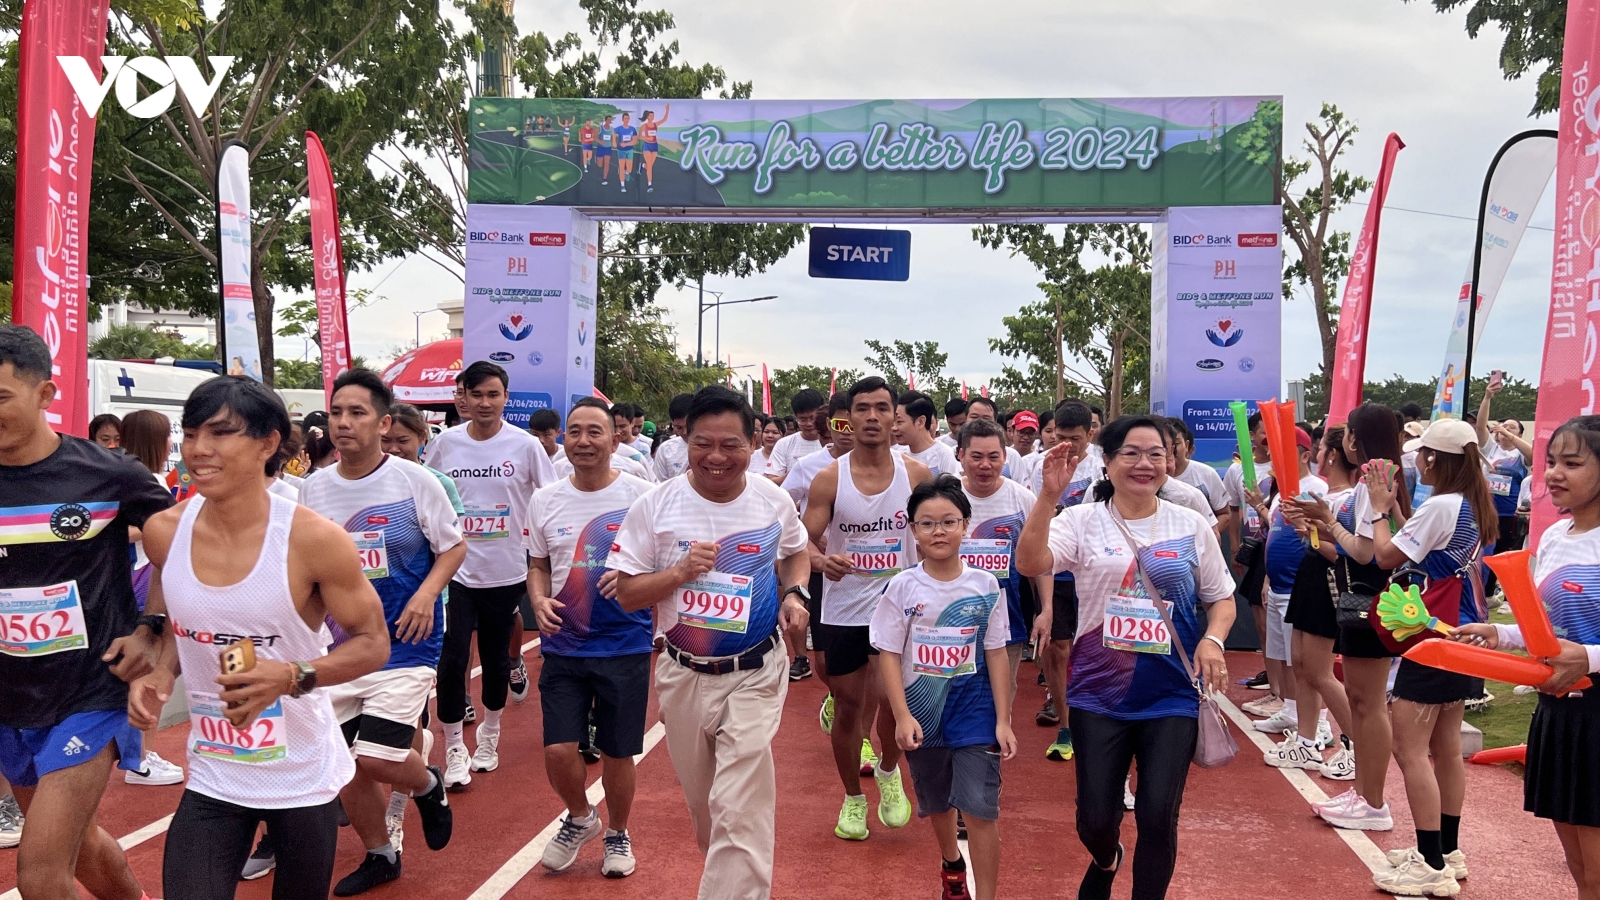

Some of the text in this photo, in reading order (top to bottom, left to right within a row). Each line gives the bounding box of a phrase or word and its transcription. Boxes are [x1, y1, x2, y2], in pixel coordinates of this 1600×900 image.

[680, 120, 1160, 193] Run for a better life 2024
[470, 231, 525, 242] BIDC Bank
[533, 235, 562, 243] metfone
[1173, 234, 1232, 245] BIDC Bank
[1241, 236, 1273, 244] metfone
[827, 244, 893, 264] START
[507, 258, 527, 273] PH
[1214, 260, 1235, 276] PH
[494, 288, 501, 296] &
[1177, 292, 1199, 300] BIDC
[1200, 292, 1207, 300] &
[1253, 292, 1274, 300] RUN
[1195, 423, 1204, 431] to
[452, 465, 501, 478] amazfit
[61, 516, 82, 527] 20
[464, 516, 505, 532] 0274
[839, 517, 892, 533] amazfit
[851, 552, 897, 569] 0080
[682, 590, 744, 619] 9999
[0, 610, 74, 642] 0562
[1110, 616, 1166, 643] 0286
[918, 644, 970, 667] 0089
[201, 716, 276, 748] 0082
